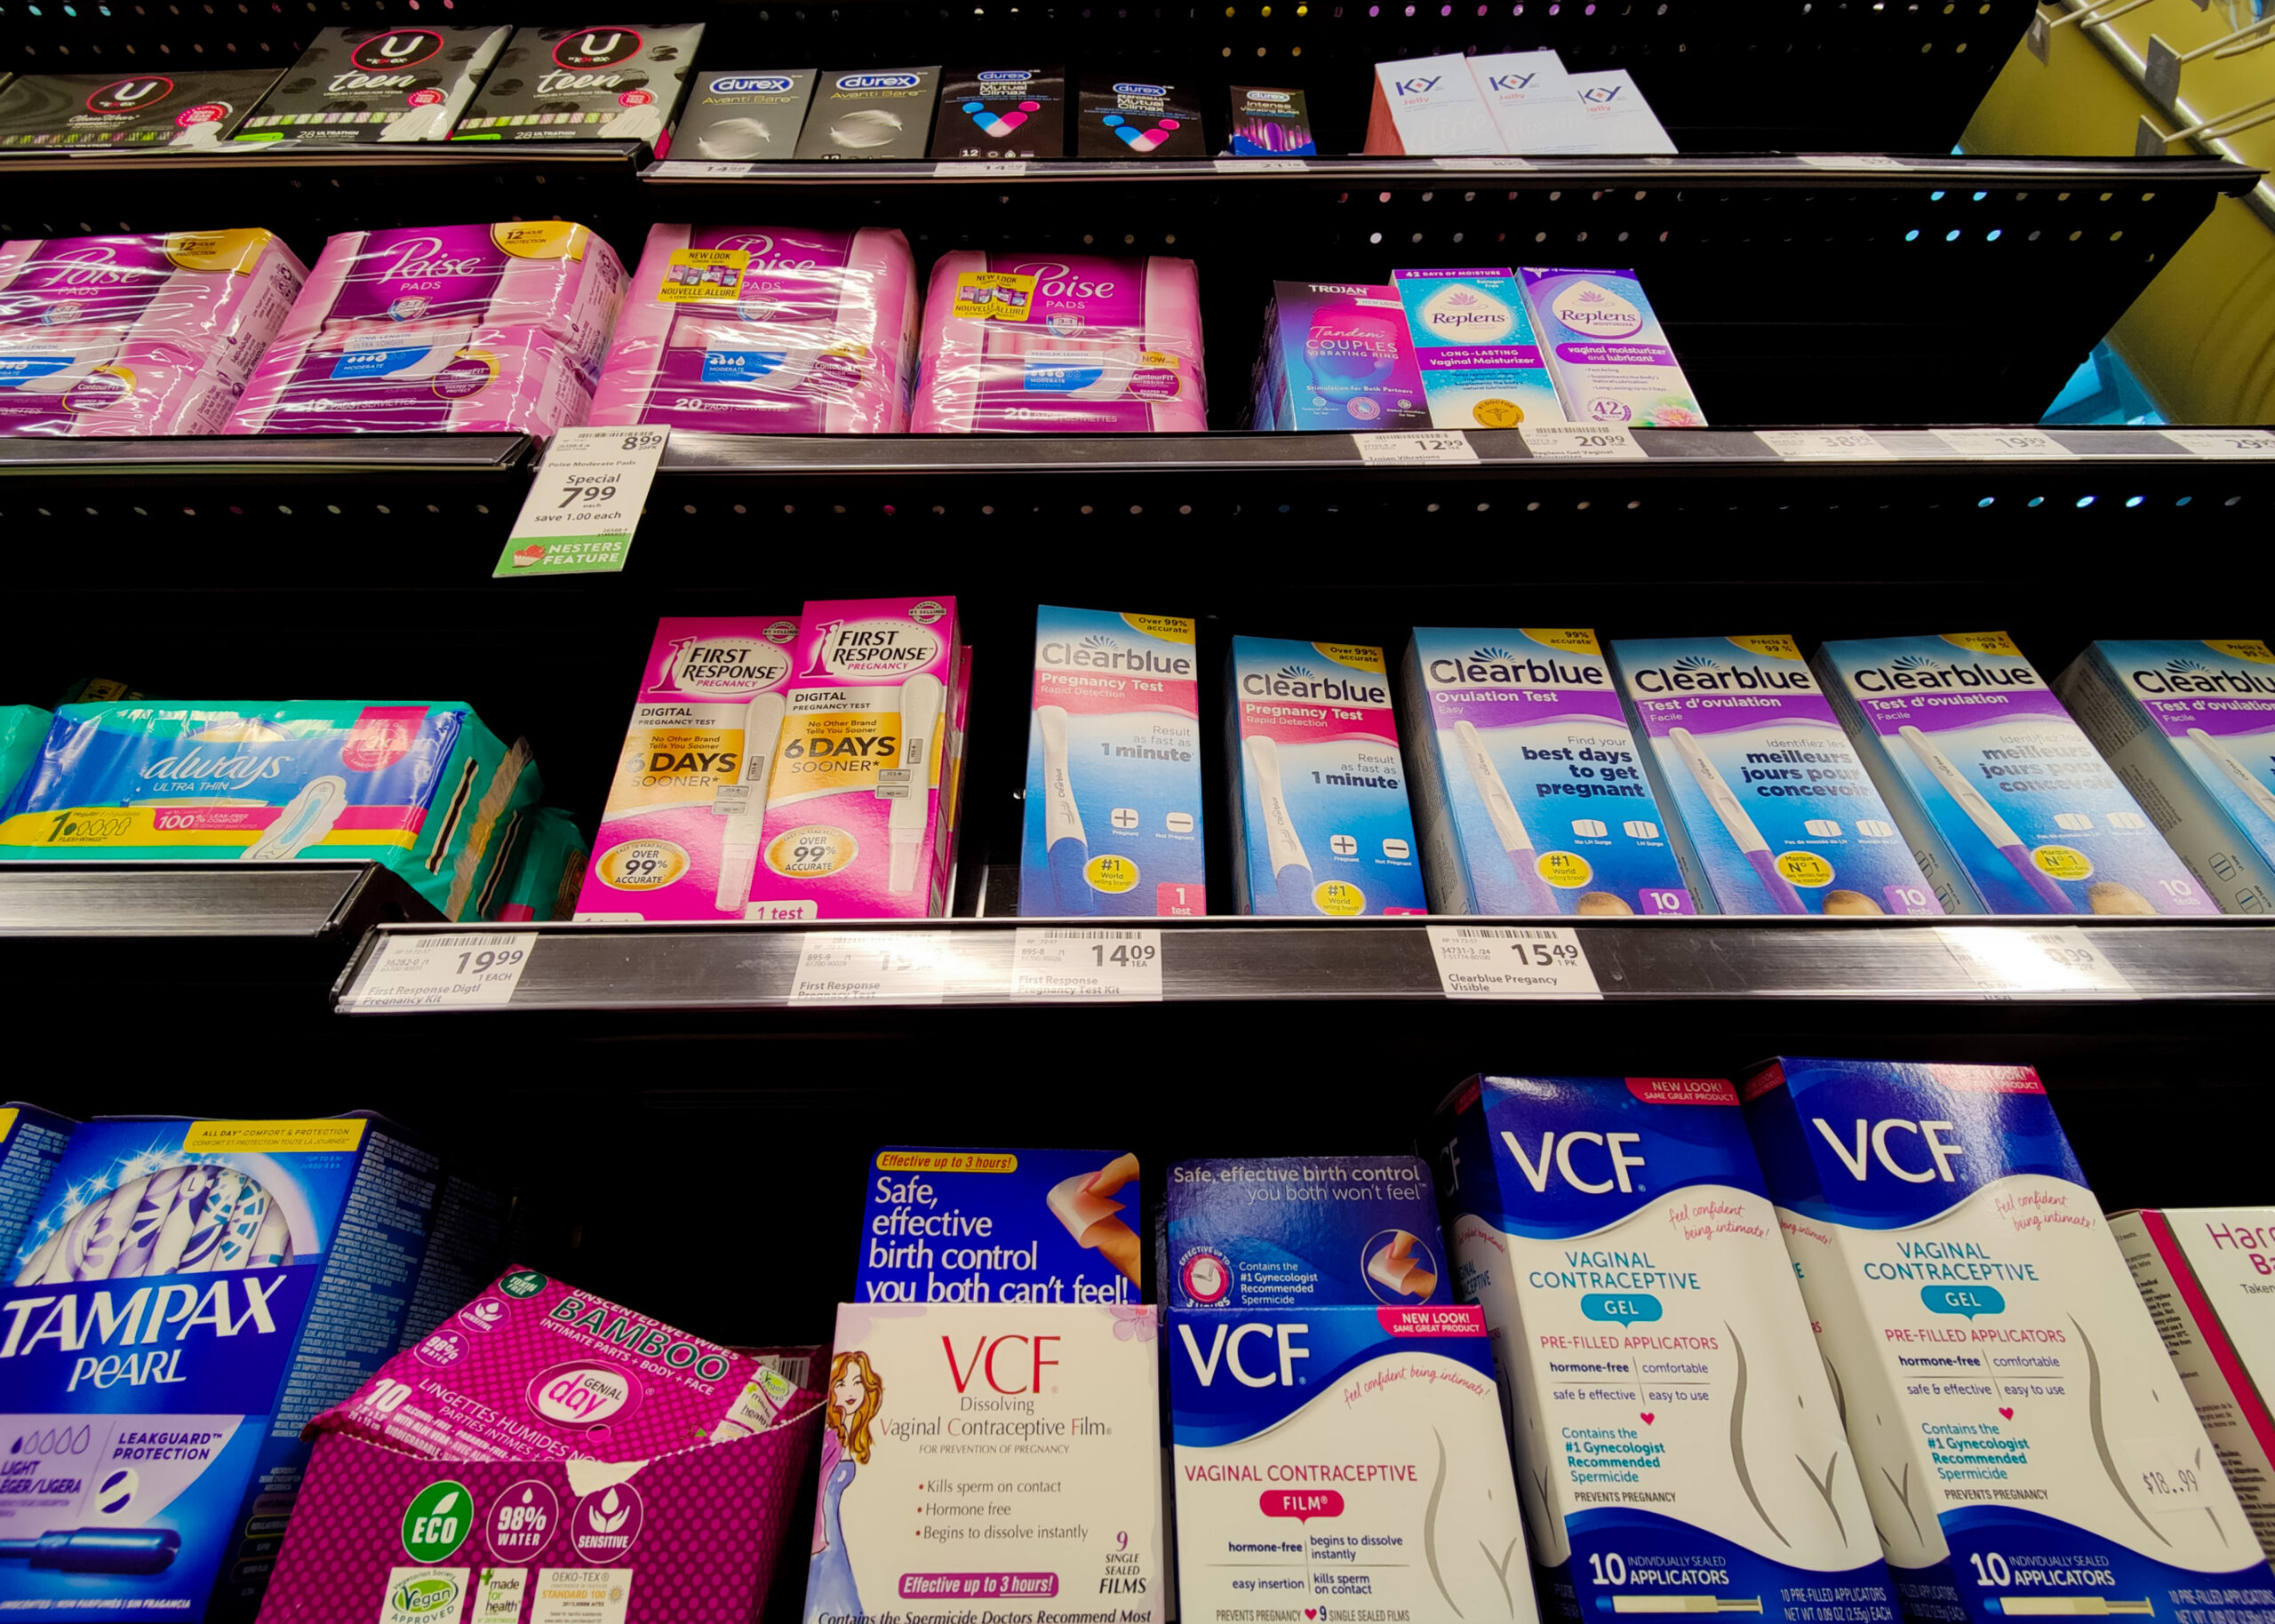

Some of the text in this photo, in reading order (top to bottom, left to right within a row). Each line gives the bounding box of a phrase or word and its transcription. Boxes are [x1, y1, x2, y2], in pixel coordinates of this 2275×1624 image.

[380, 36, 424, 57] U
[329, 70, 419, 92] teen
[538, 70, 622, 92] teen
[718, 77, 785, 91] durex
[844, 76, 911, 88] durex
[1118, 85, 1159, 94] durex
[703, 95, 752, 105] Avanti
[378, 237, 482, 284] Poise
[400, 282, 441, 291] PADS
[1014, 262, 1114, 298] Poise
[1308, 284, 1367, 295] TROJAN
[1432, 311, 1505, 325] Replens
[1561, 308, 1636, 322] Replens
[1306, 339, 1398, 354] COUPLES
[1568, 346, 1666, 356] vaginal moisturizer
[1429, 356, 1535, 367] Vaginal Moisturizer
[1608, 354, 1655, 362] lubricant
[675, 399, 702, 409] 20
[1594, 401, 1622, 415] 42
[566, 474, 621, 485] Special
[548, 542, 622, 553] NESTERS
[543, 553, 619, 565] FEATURE
[839, 632, 898, 647] FIRST
[690, 648, 750, 664] FIRST
[834, 647, 926, 663] RESPONSE
[1042, 642, 1191, 675] Clearblue
[682, 665, 777, 681] RESPONSE
[847, 662, 908, 671] PREGNANCY
[1431, 658, 1603, 685] Clearblue
[1042, 673, 1164, 692] Pregnancy Test
[1635, 668, 1811, 693] Clearblue
[1855, 663, 2035, 691] Clearblue
[1244, 674, 1385, 703] Clearblue
[794, 693, 846, 702] DIGITAL
[1436, 691, 1558, 704] Ovulation Test
[1868, 693, 2009, 710] Test d'ovulation
[1247, 716, 1328, 728] Rapid Detection
[1650, 712, 1682, 722] Facile
[785, 736, 896, 758] 6 DAYS
[1358, 754, 1394, 765] Result
[1522, 746, 1632, 764] best days
[1746, 750, 1853, 765] meilleurs
[145, 747, 291, 790] always
[1569, 765, 1639, 780] to get
[154, 781, 229, 792] ULTRA THIN
[1313, 771, 1399, 789] 1 minute
[1537, 782, 1645, 798] pregnant
[1651, 892, 1680, 910] 10
[758, 907, 803, 919] 1 test
[1449, 974, 1558, 986] Clearblue Pregancy
[1451, 983, 1490, 992] Visible
[369, 986, 396, 995] First
[398, 984, 449, 996] Response
[1812, 1118, 1965, 1182] VCF
[882, 1155, 1010, 1168] Effective up to 3 hours!
[1501, 1132, 1645, 1194] VCF
[875, 1175, 938, 1209] Safe,
[873, 1206, 993, 1237] effective
[869, 1238, 1038, 1270] birth control
[1565, 1252, 1655, 1268] VAGINAL
[1529, 1272, 1700, 1289] CONTRACEPTIVE
[1605, 1301, 1639, 1314] GEL
[0, 1275, 287, 1358] TAMPAX
[540, 1318, 631, 1363] INTIMATE PARTS
[548, 1298, 730, 1381] BAMBOO
[1886, 1330, 2066, 1343] PRE-FILLED APPLICATORS
[1179, 1324, 1309, 1387] VCF
[1993, 1357, 2060, 1367] comfortable
[942, 1335, 1060, 1395] VCF
[584, 1376, 623, 1401] GENIAL
[547, 1373, 607, 1421] day
[961, 1397, 1034, 1415] Dissolving
[113, 1448, 210, 1461] PROTECTION
[1569, 1456, 1660, 1468] Recommended
[1185, 1466, 1417, 1482] VAGINAL CONTRACEPTIVE
[927, 1480, 1061, 1496] Kills sperm on contact
[498, 1506, 547, 1532] 98%
[412, 1517, 457, 1544] ECO
[498, 1533, 540, 1546] WATER
[579, 1535, 629, 1548] SENSITIVE
[1228, 1542, 1302, 1552] hormone-free
[1106, 1554, 1139, 1564] SINGLE
[1106, 1565, 1139, 1575] SEALED
[1630, 1570, 1729, 1585] APPLICATORS
[1099, 1579, 1146, 1594] FILMS
